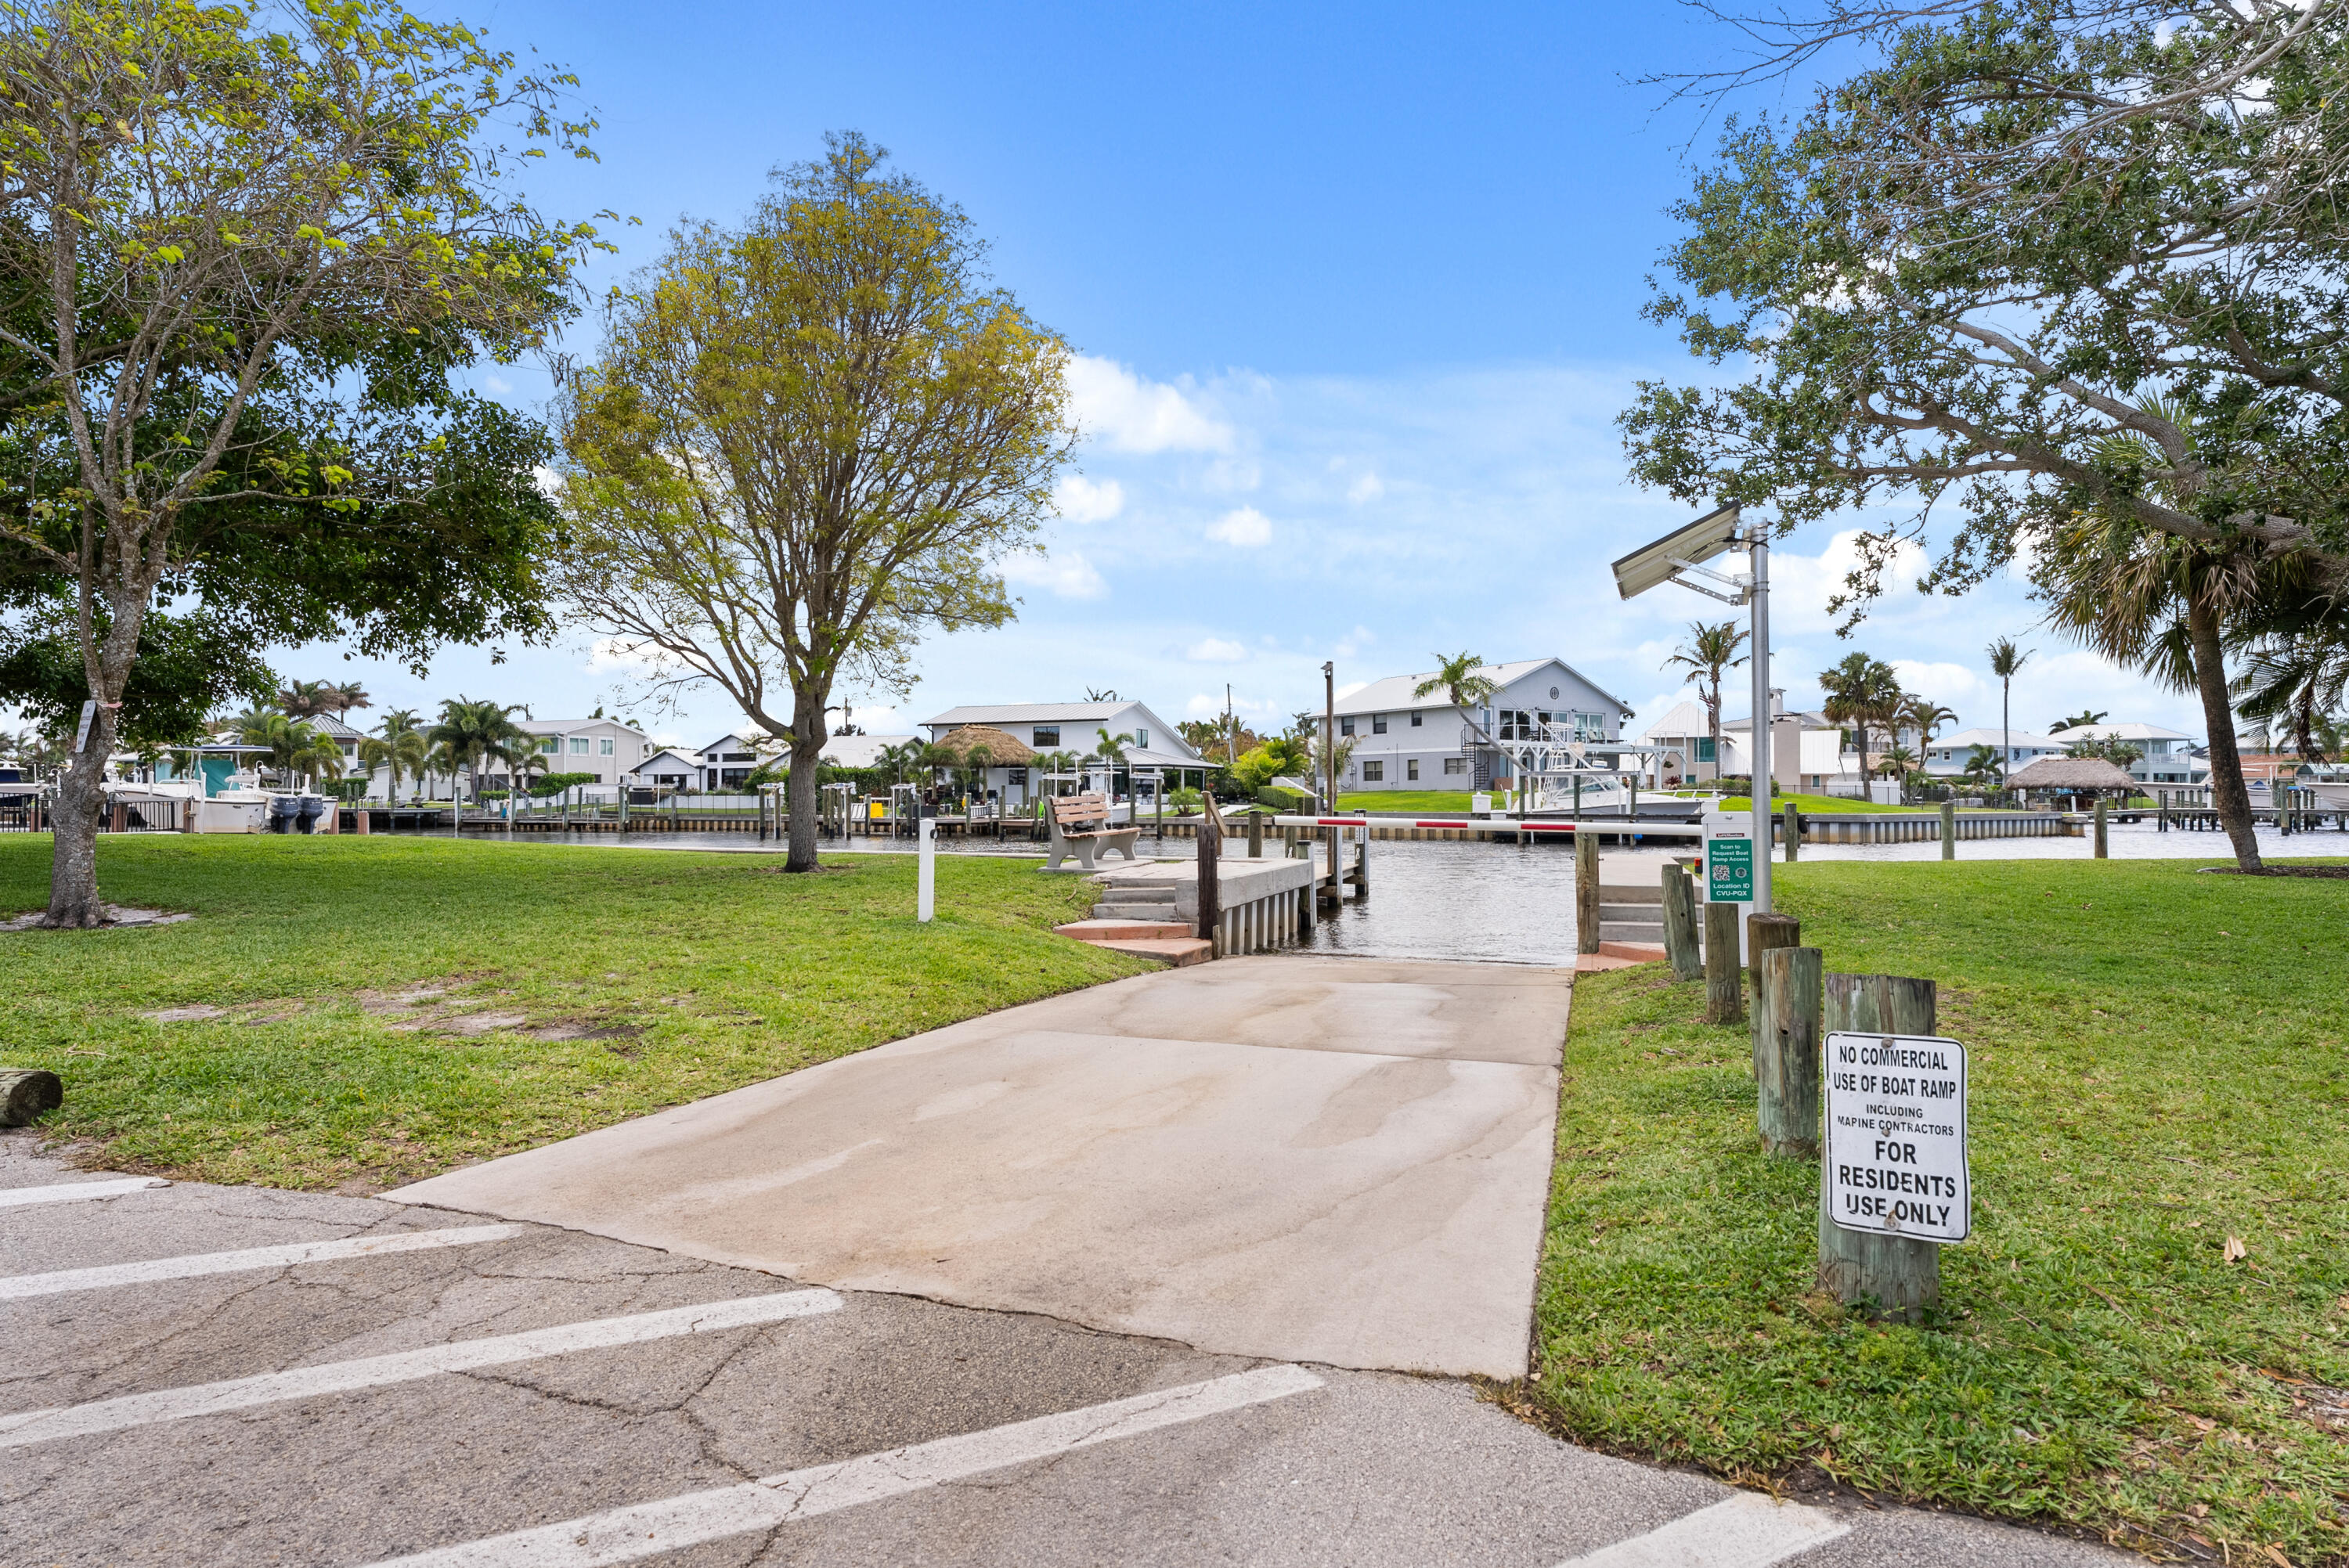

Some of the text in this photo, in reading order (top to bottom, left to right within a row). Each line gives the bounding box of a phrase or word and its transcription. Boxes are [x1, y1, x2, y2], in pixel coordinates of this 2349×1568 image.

[1839, 1045, 1948, 1071] NO COMMERCIAL
[1834, 1072, 1956, 1099] USE OF BOAT RAMP
[1866, 1104, 1923, 1119] INCLUDING
[1878, 1119, 1954, 1136] CONTRACTORS
[1875, 1140, 1917, 1164] FOR
[1839, 1164, 1956, 1199] RESIDENTS
[1846, 1193, 1950, 1227] USE ONLY
